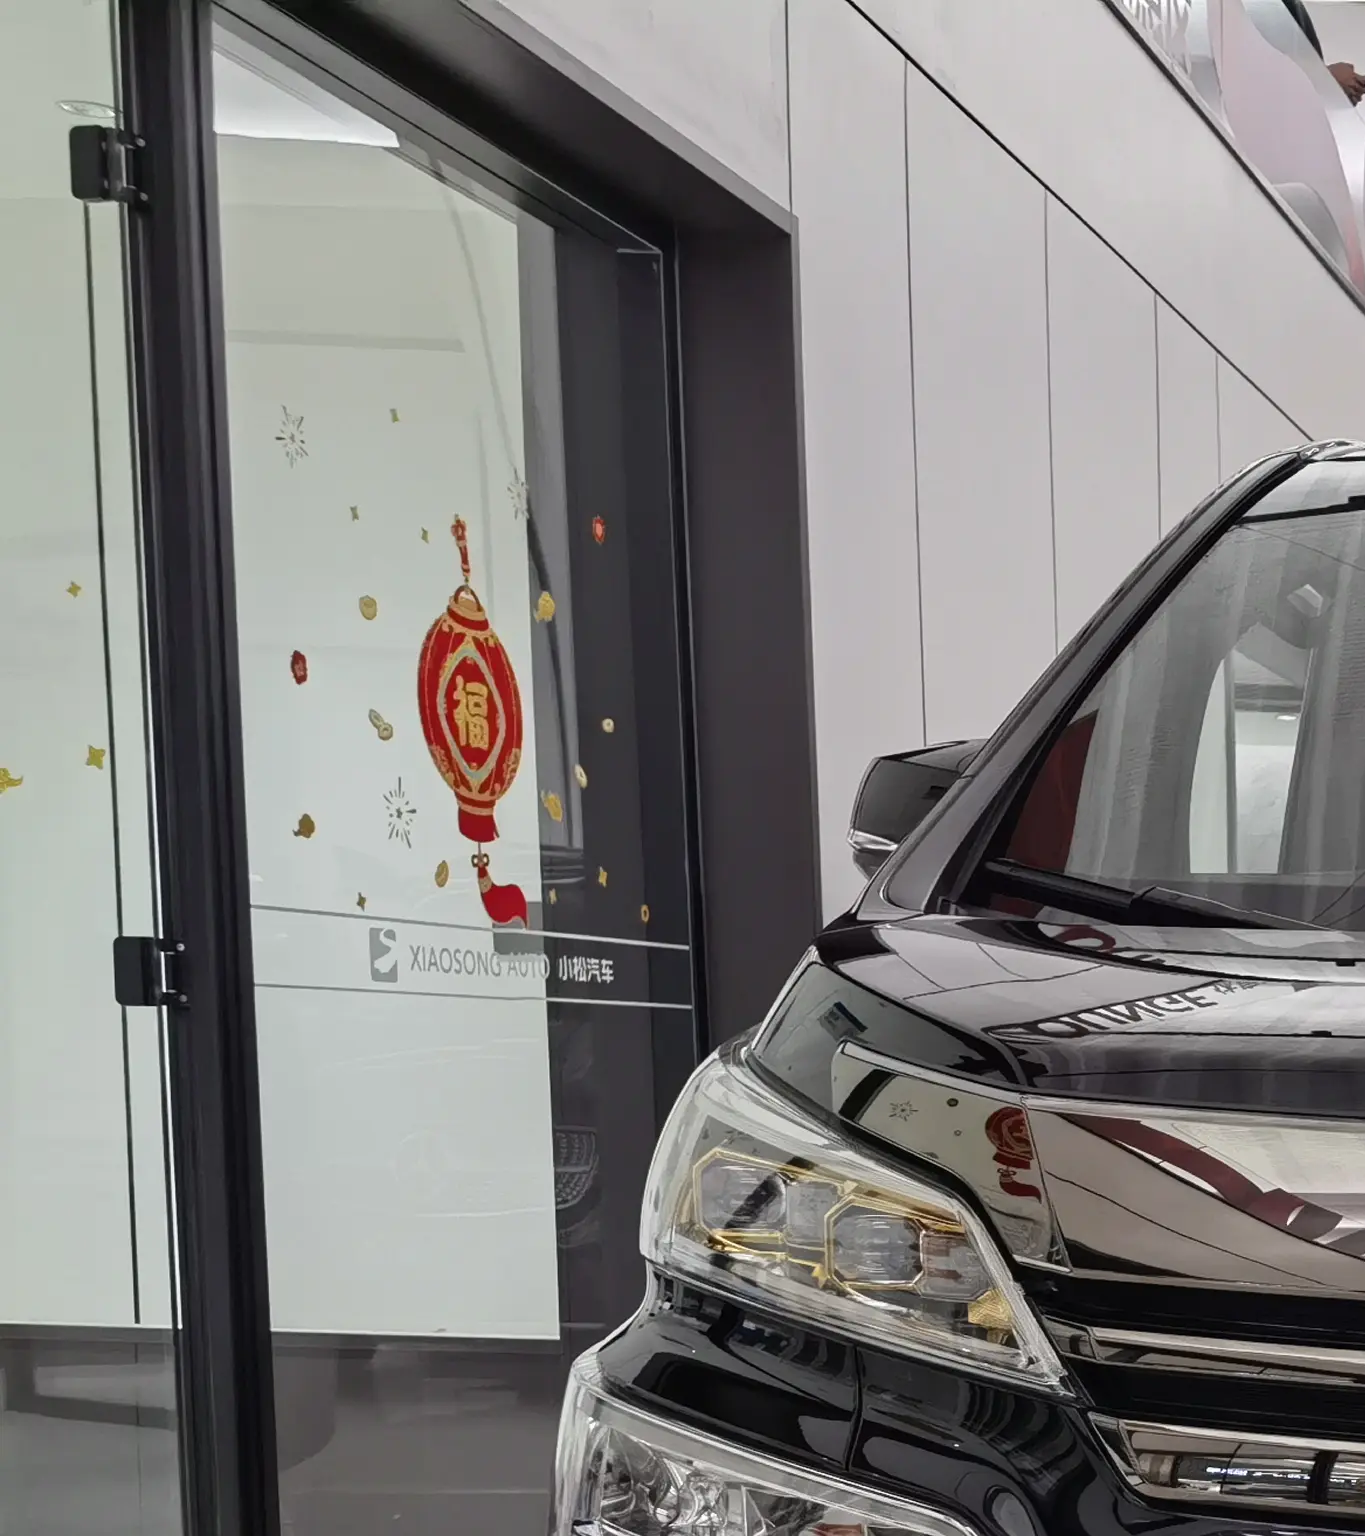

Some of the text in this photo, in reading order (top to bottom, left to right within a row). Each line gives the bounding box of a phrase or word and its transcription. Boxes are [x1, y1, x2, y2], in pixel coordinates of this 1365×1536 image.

[409, 944, 614, 984] XIAOSONG AUTO 小松汽车
